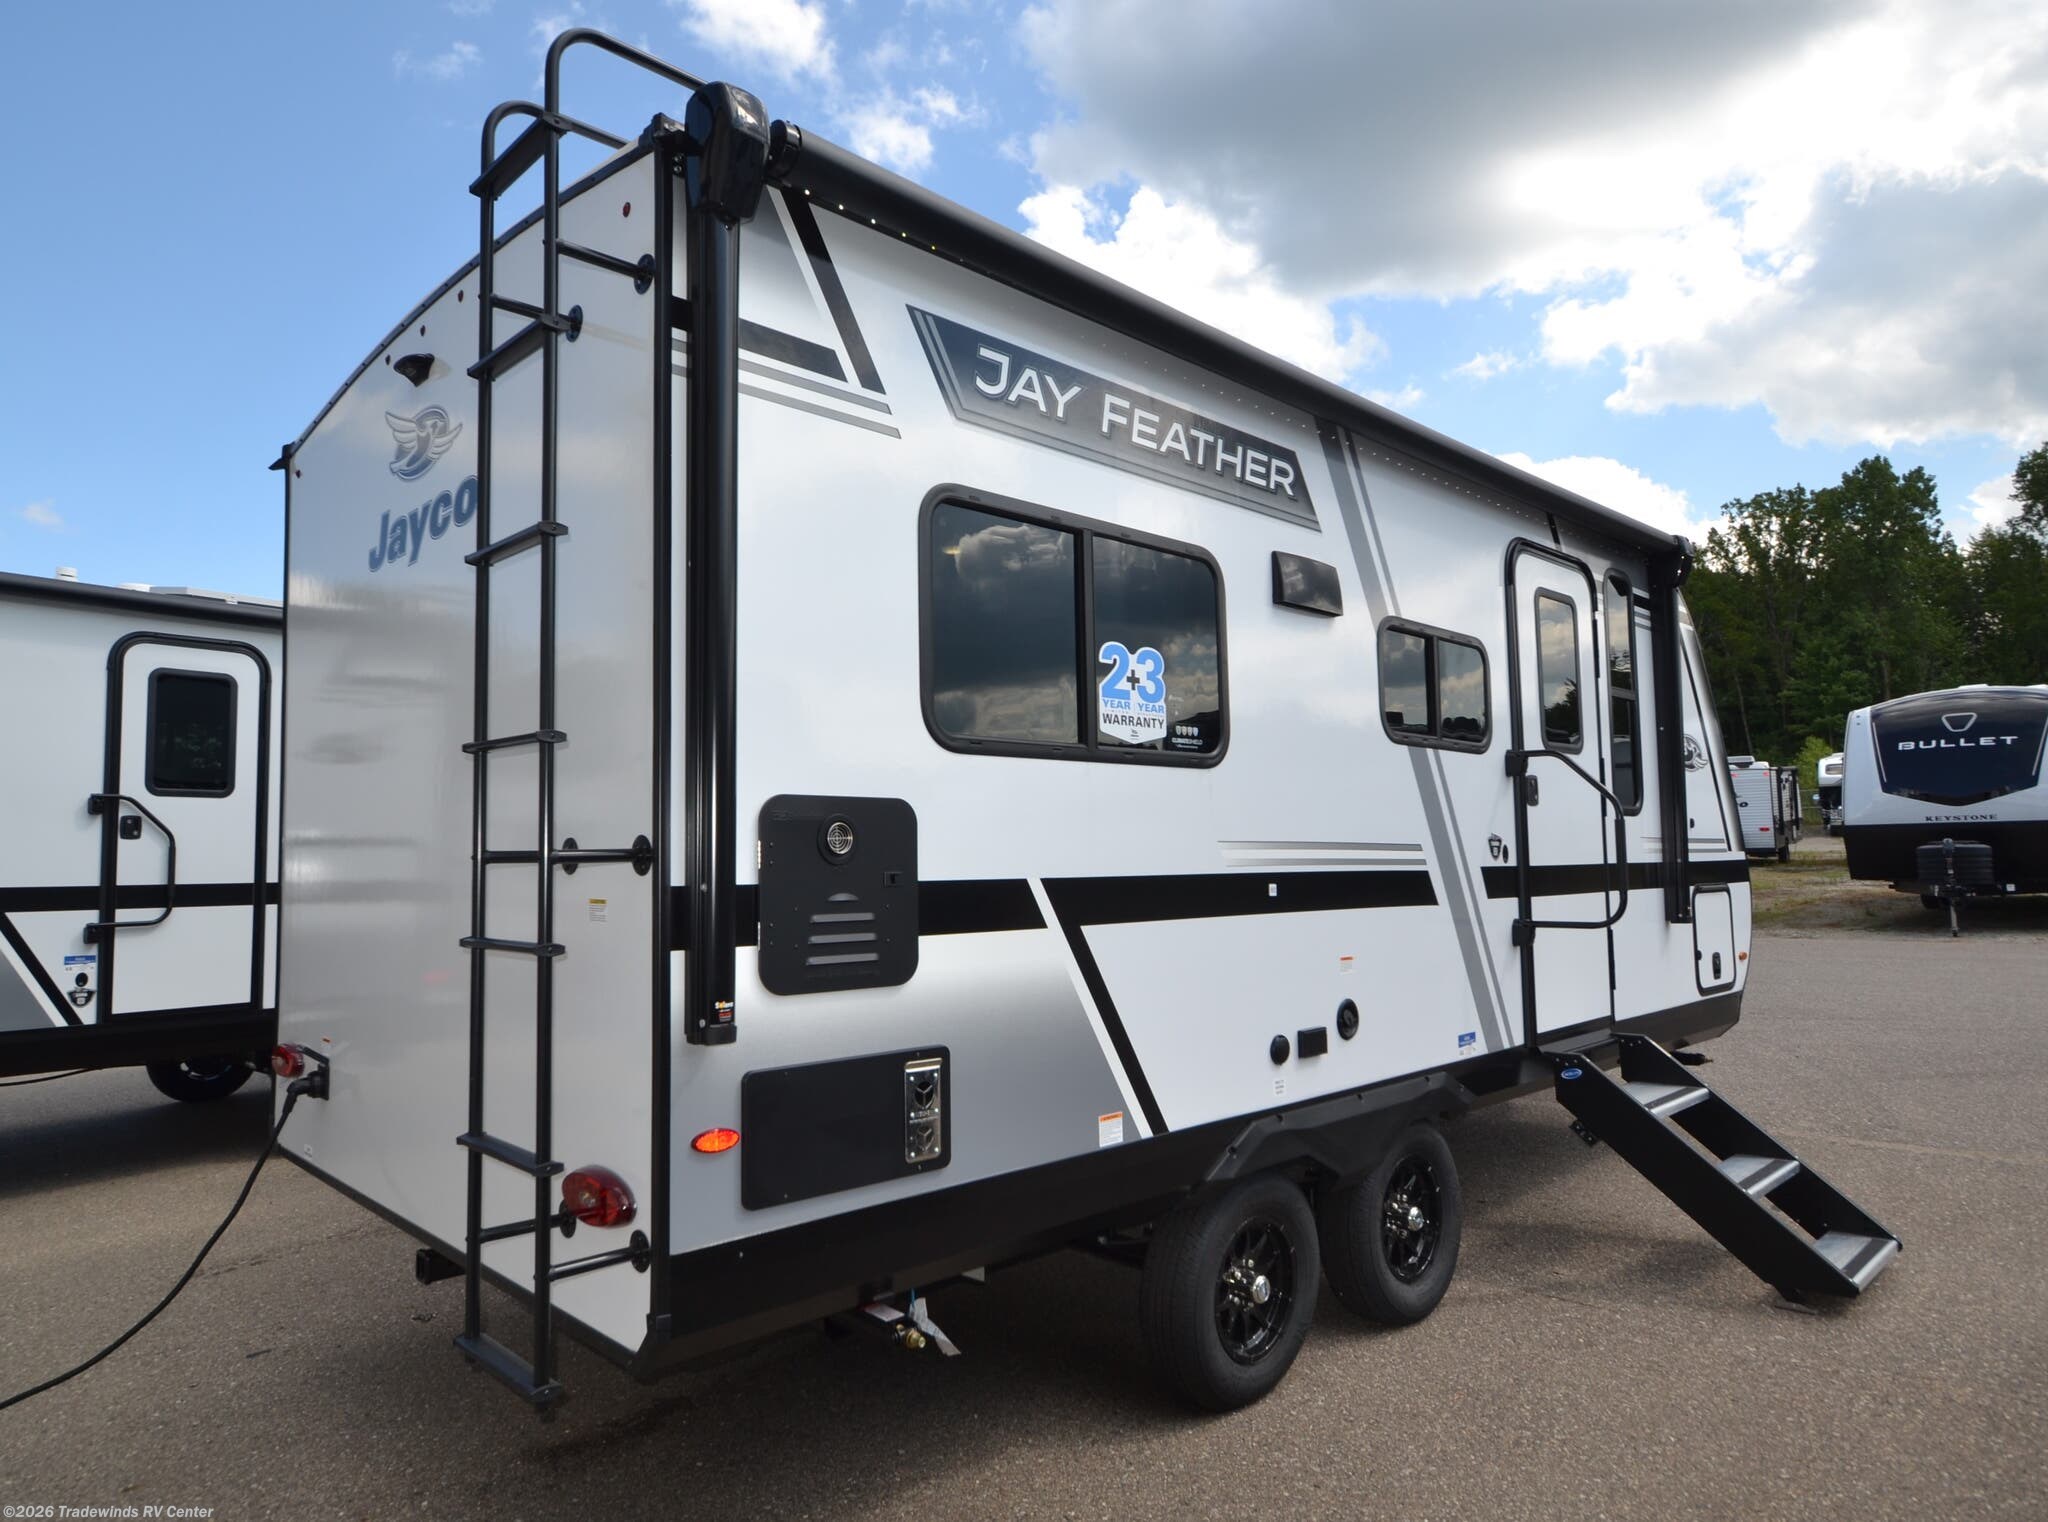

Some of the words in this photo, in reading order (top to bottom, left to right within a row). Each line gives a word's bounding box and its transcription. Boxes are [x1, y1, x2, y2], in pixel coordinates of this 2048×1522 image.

[974, 345, 1084, 421] JAY
[1101, 393, 1296, 497] FEATHER
[368, 475, 479, 573] Jayco
[1102, 698, 1131, 710] YEAR
[1137, 702, 1165, 714] YEAR
[1102, 712, 1165, 730] WARRANTY
[1898, 736, 2018, 750] BULLET
[1925, 814, 1998, 822] KEYSTONE
